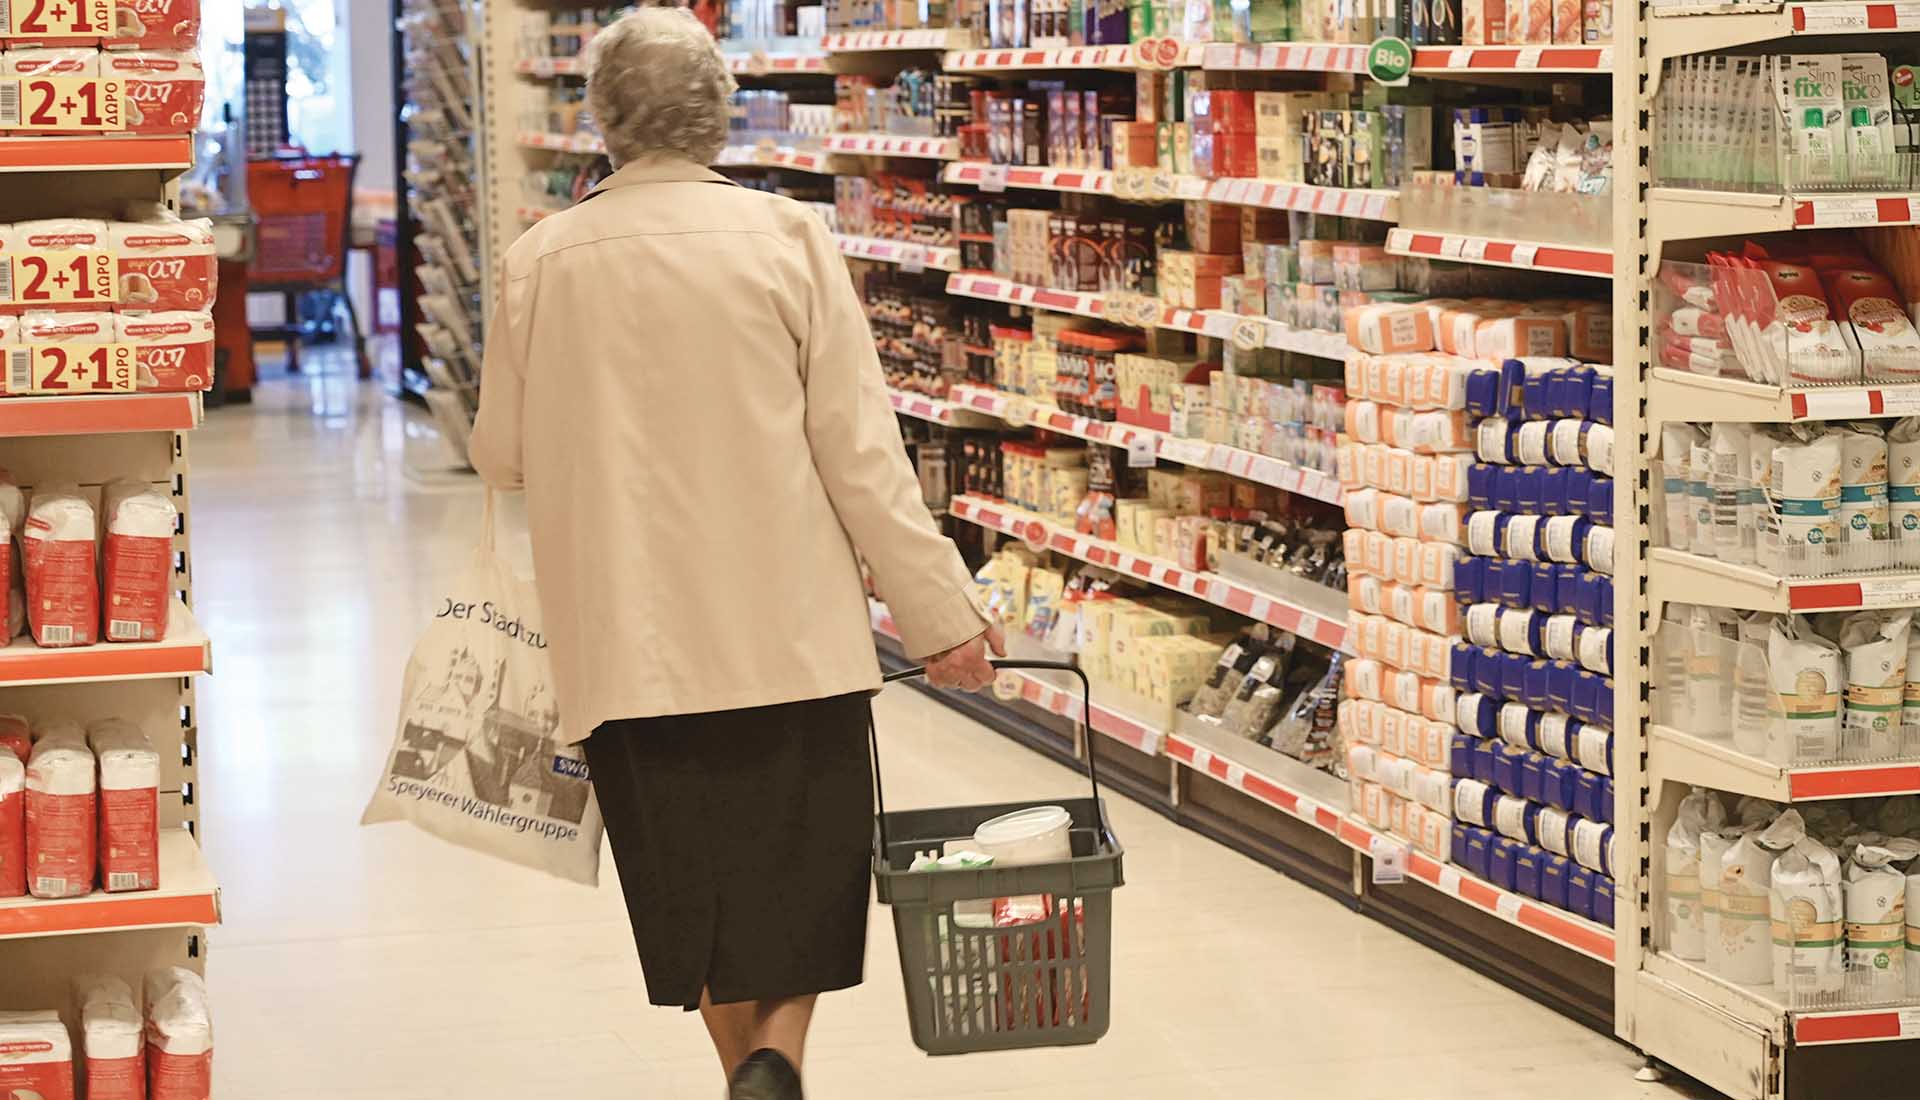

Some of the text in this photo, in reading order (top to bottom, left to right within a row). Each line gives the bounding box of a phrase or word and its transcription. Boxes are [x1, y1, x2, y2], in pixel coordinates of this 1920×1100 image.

[20, 0, 93, 33] 2+1
[95, 0, 109, 32] ΔΩΡ
[1376, 48, 1405, 67] Bio
[1808, 68, 1836, 82] Slim
[1852, 71, 1881, 84] Slim
[29, 80, 102, 126] 2+1
[104, 82, 118, 125] ΔΩΡΟ
[1794, 77, 1823, 97] fix
[21, 255, 95, 300] 2+1
[97, 255, 110, 297] ΔΩΡΟ
[40, 347, 113, 389] 2+1
[116, 347, 129, 389] ΔΩΡΟ
[387, 775, 578, 842] Speyerer Wählergruppe
